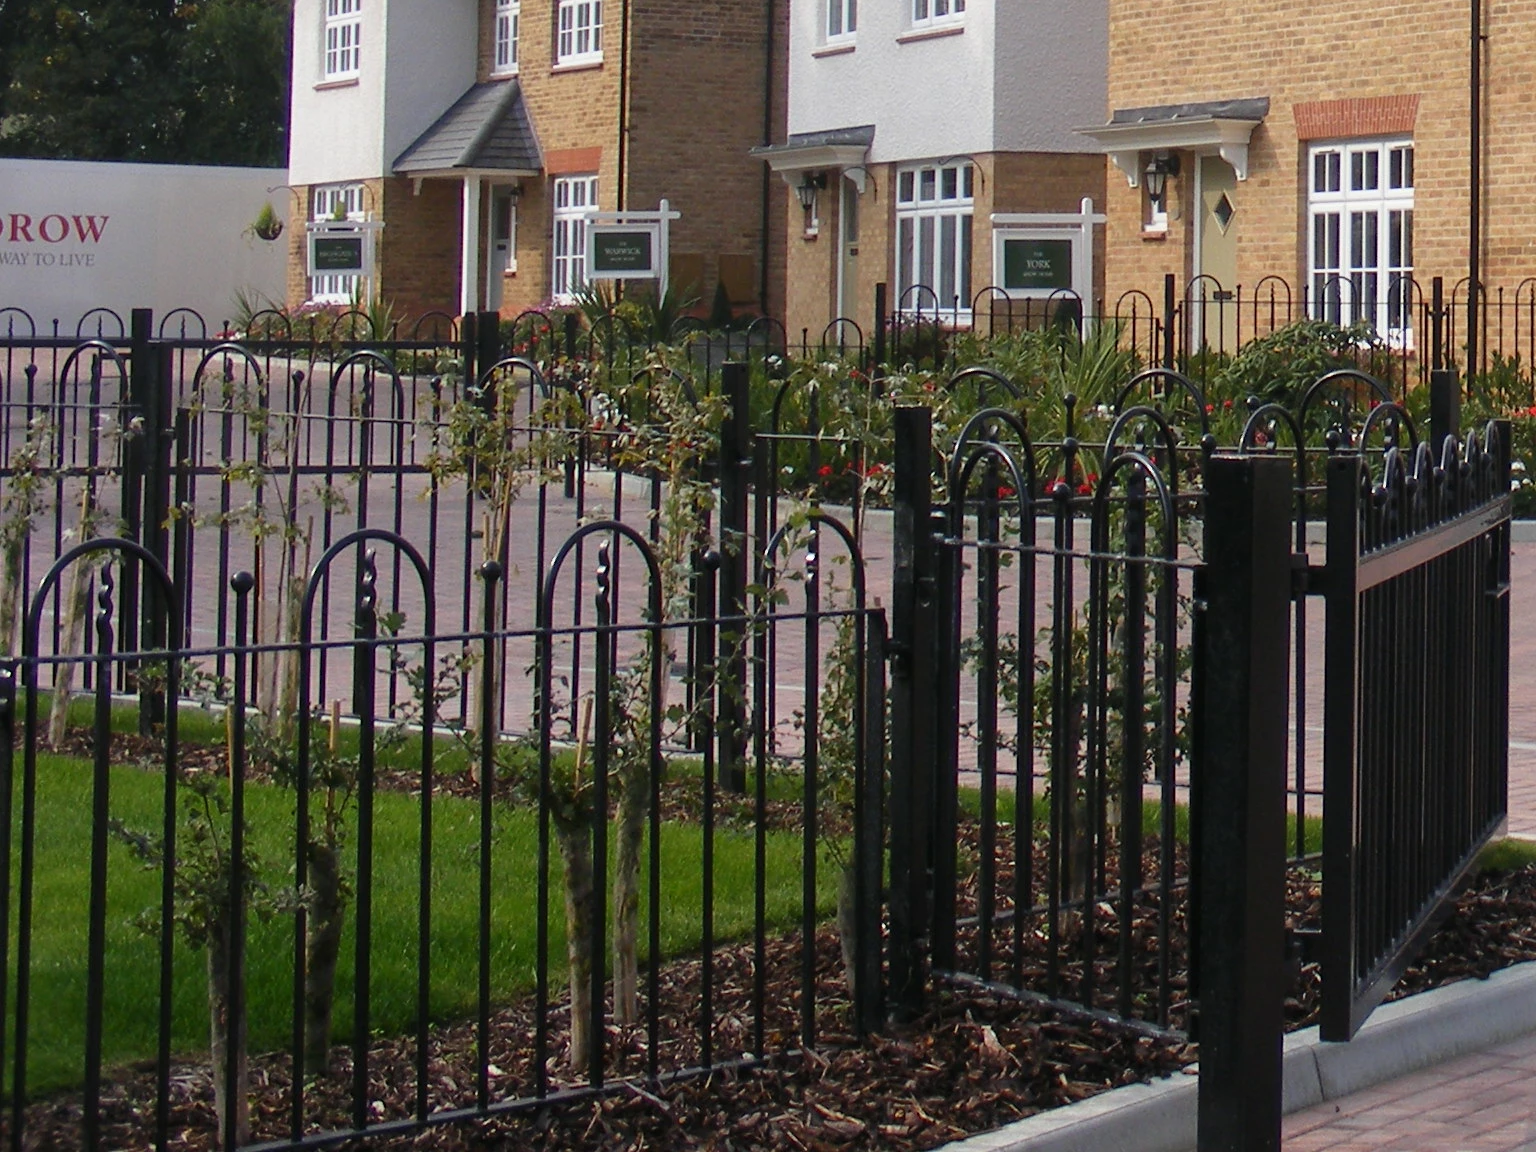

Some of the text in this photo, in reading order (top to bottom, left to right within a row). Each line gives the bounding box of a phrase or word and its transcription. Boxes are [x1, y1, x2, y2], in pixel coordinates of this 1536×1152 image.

[0, 213, 110, 244] ROW
[33, 252, 56, 266] TO
[59, 253, 95, 267] LIVE
[1026, 259, 1051, 269] YORK
